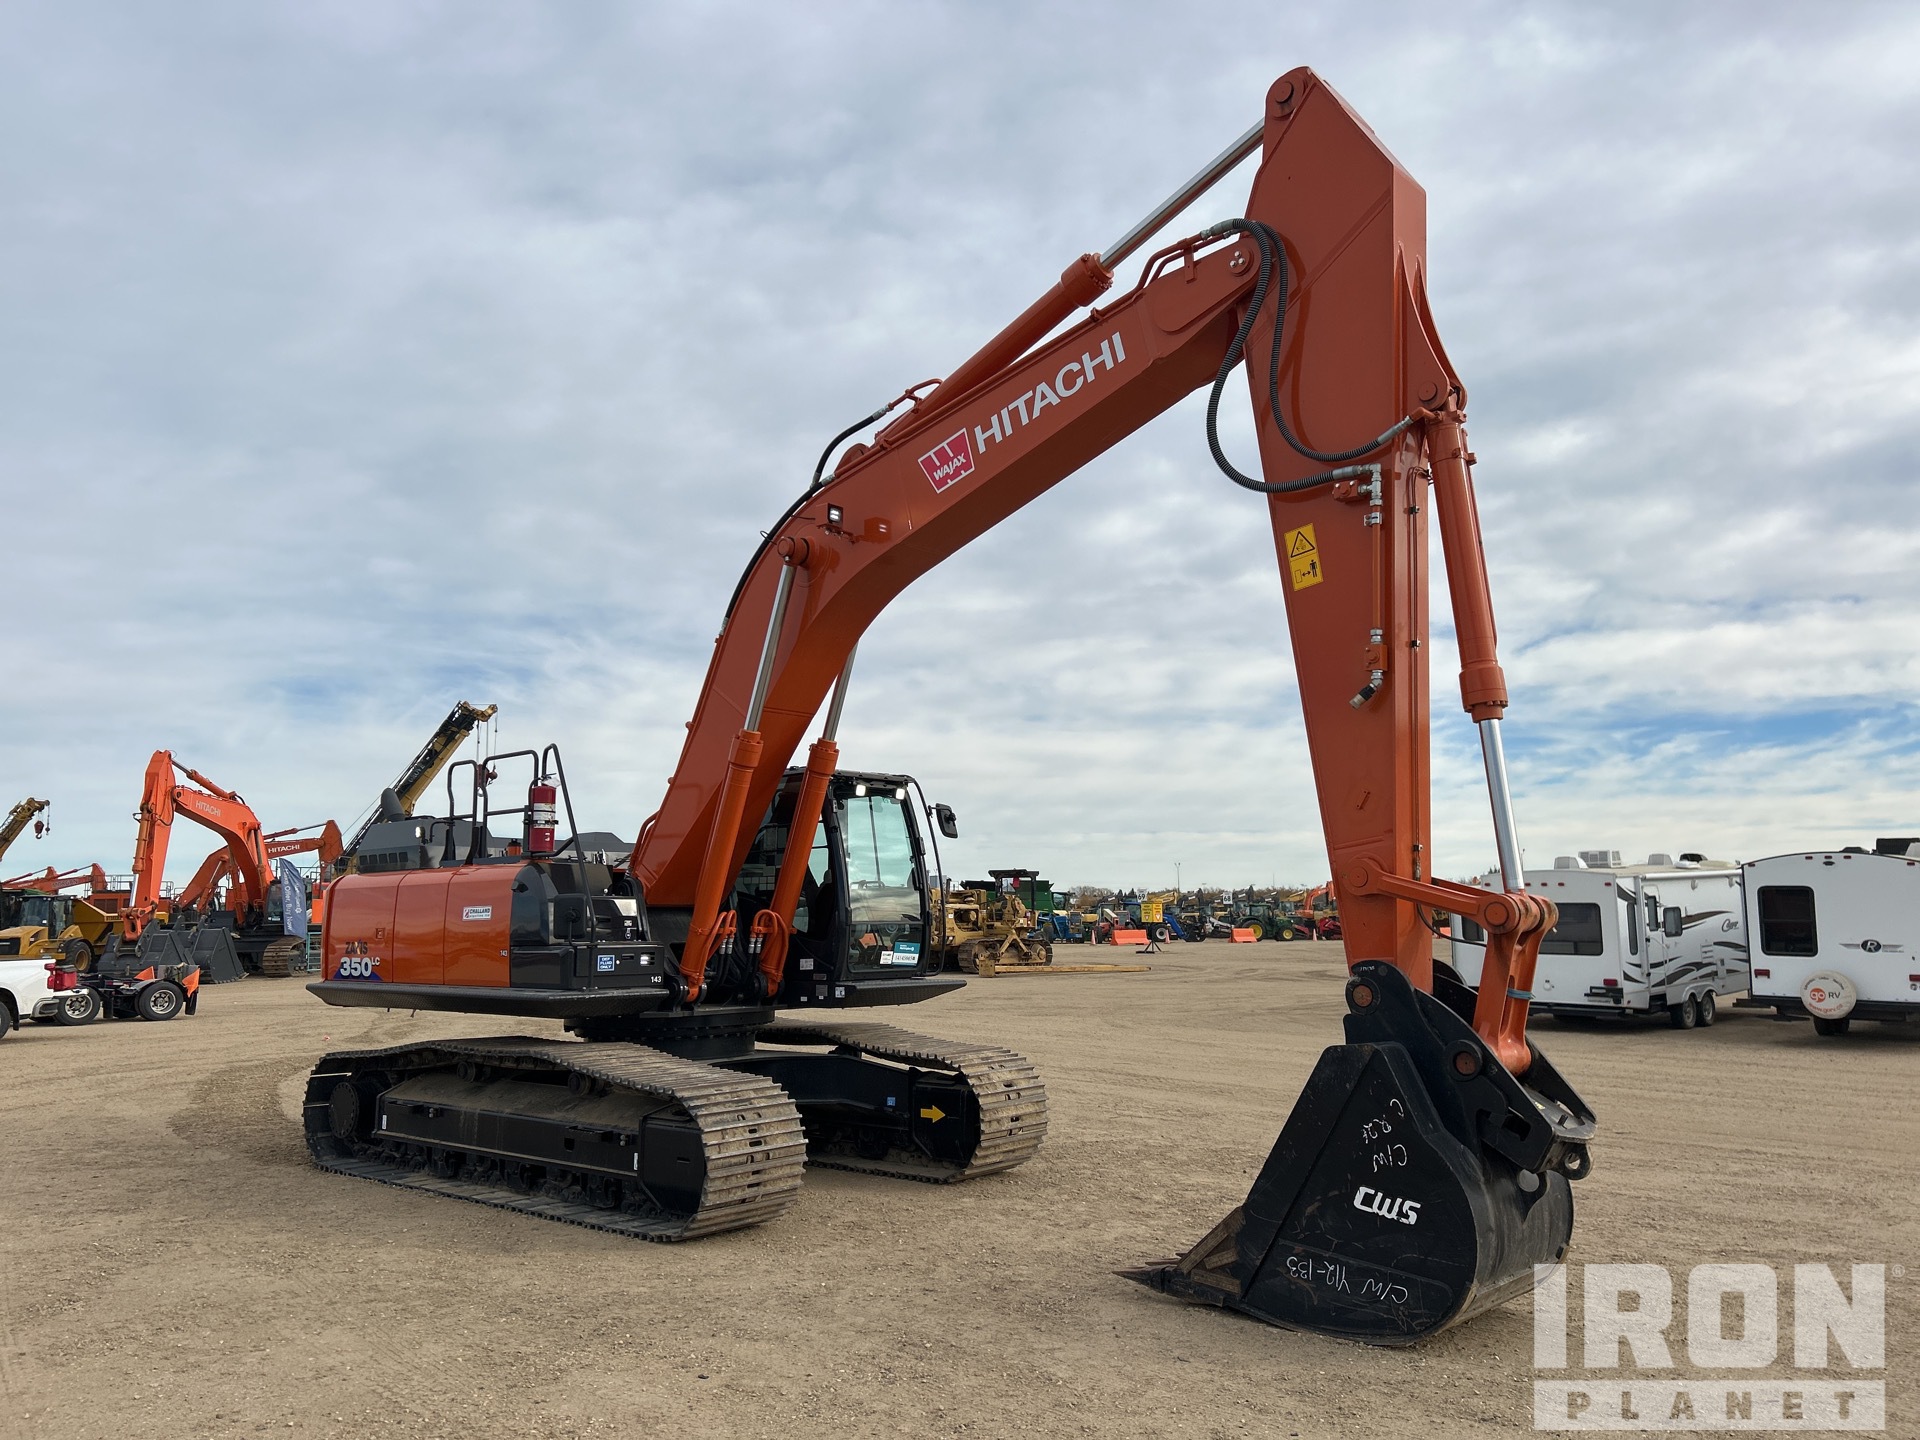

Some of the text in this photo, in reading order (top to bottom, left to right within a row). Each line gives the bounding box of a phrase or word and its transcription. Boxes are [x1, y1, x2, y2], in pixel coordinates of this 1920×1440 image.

[974, 331, 1126, 454] HITACHI
[933, 453, 967, 481] WAJAX
[195, 800, 221, 817] HITACHI
[268, 844, 300, 853] HITACHI
[285, 903, 293, 916] Buy
[1811, 992, 1825, 1002] go
[1353, 1186, 1421, 1225] CWS
[1361, 1278, 1408, 1304] C/W
